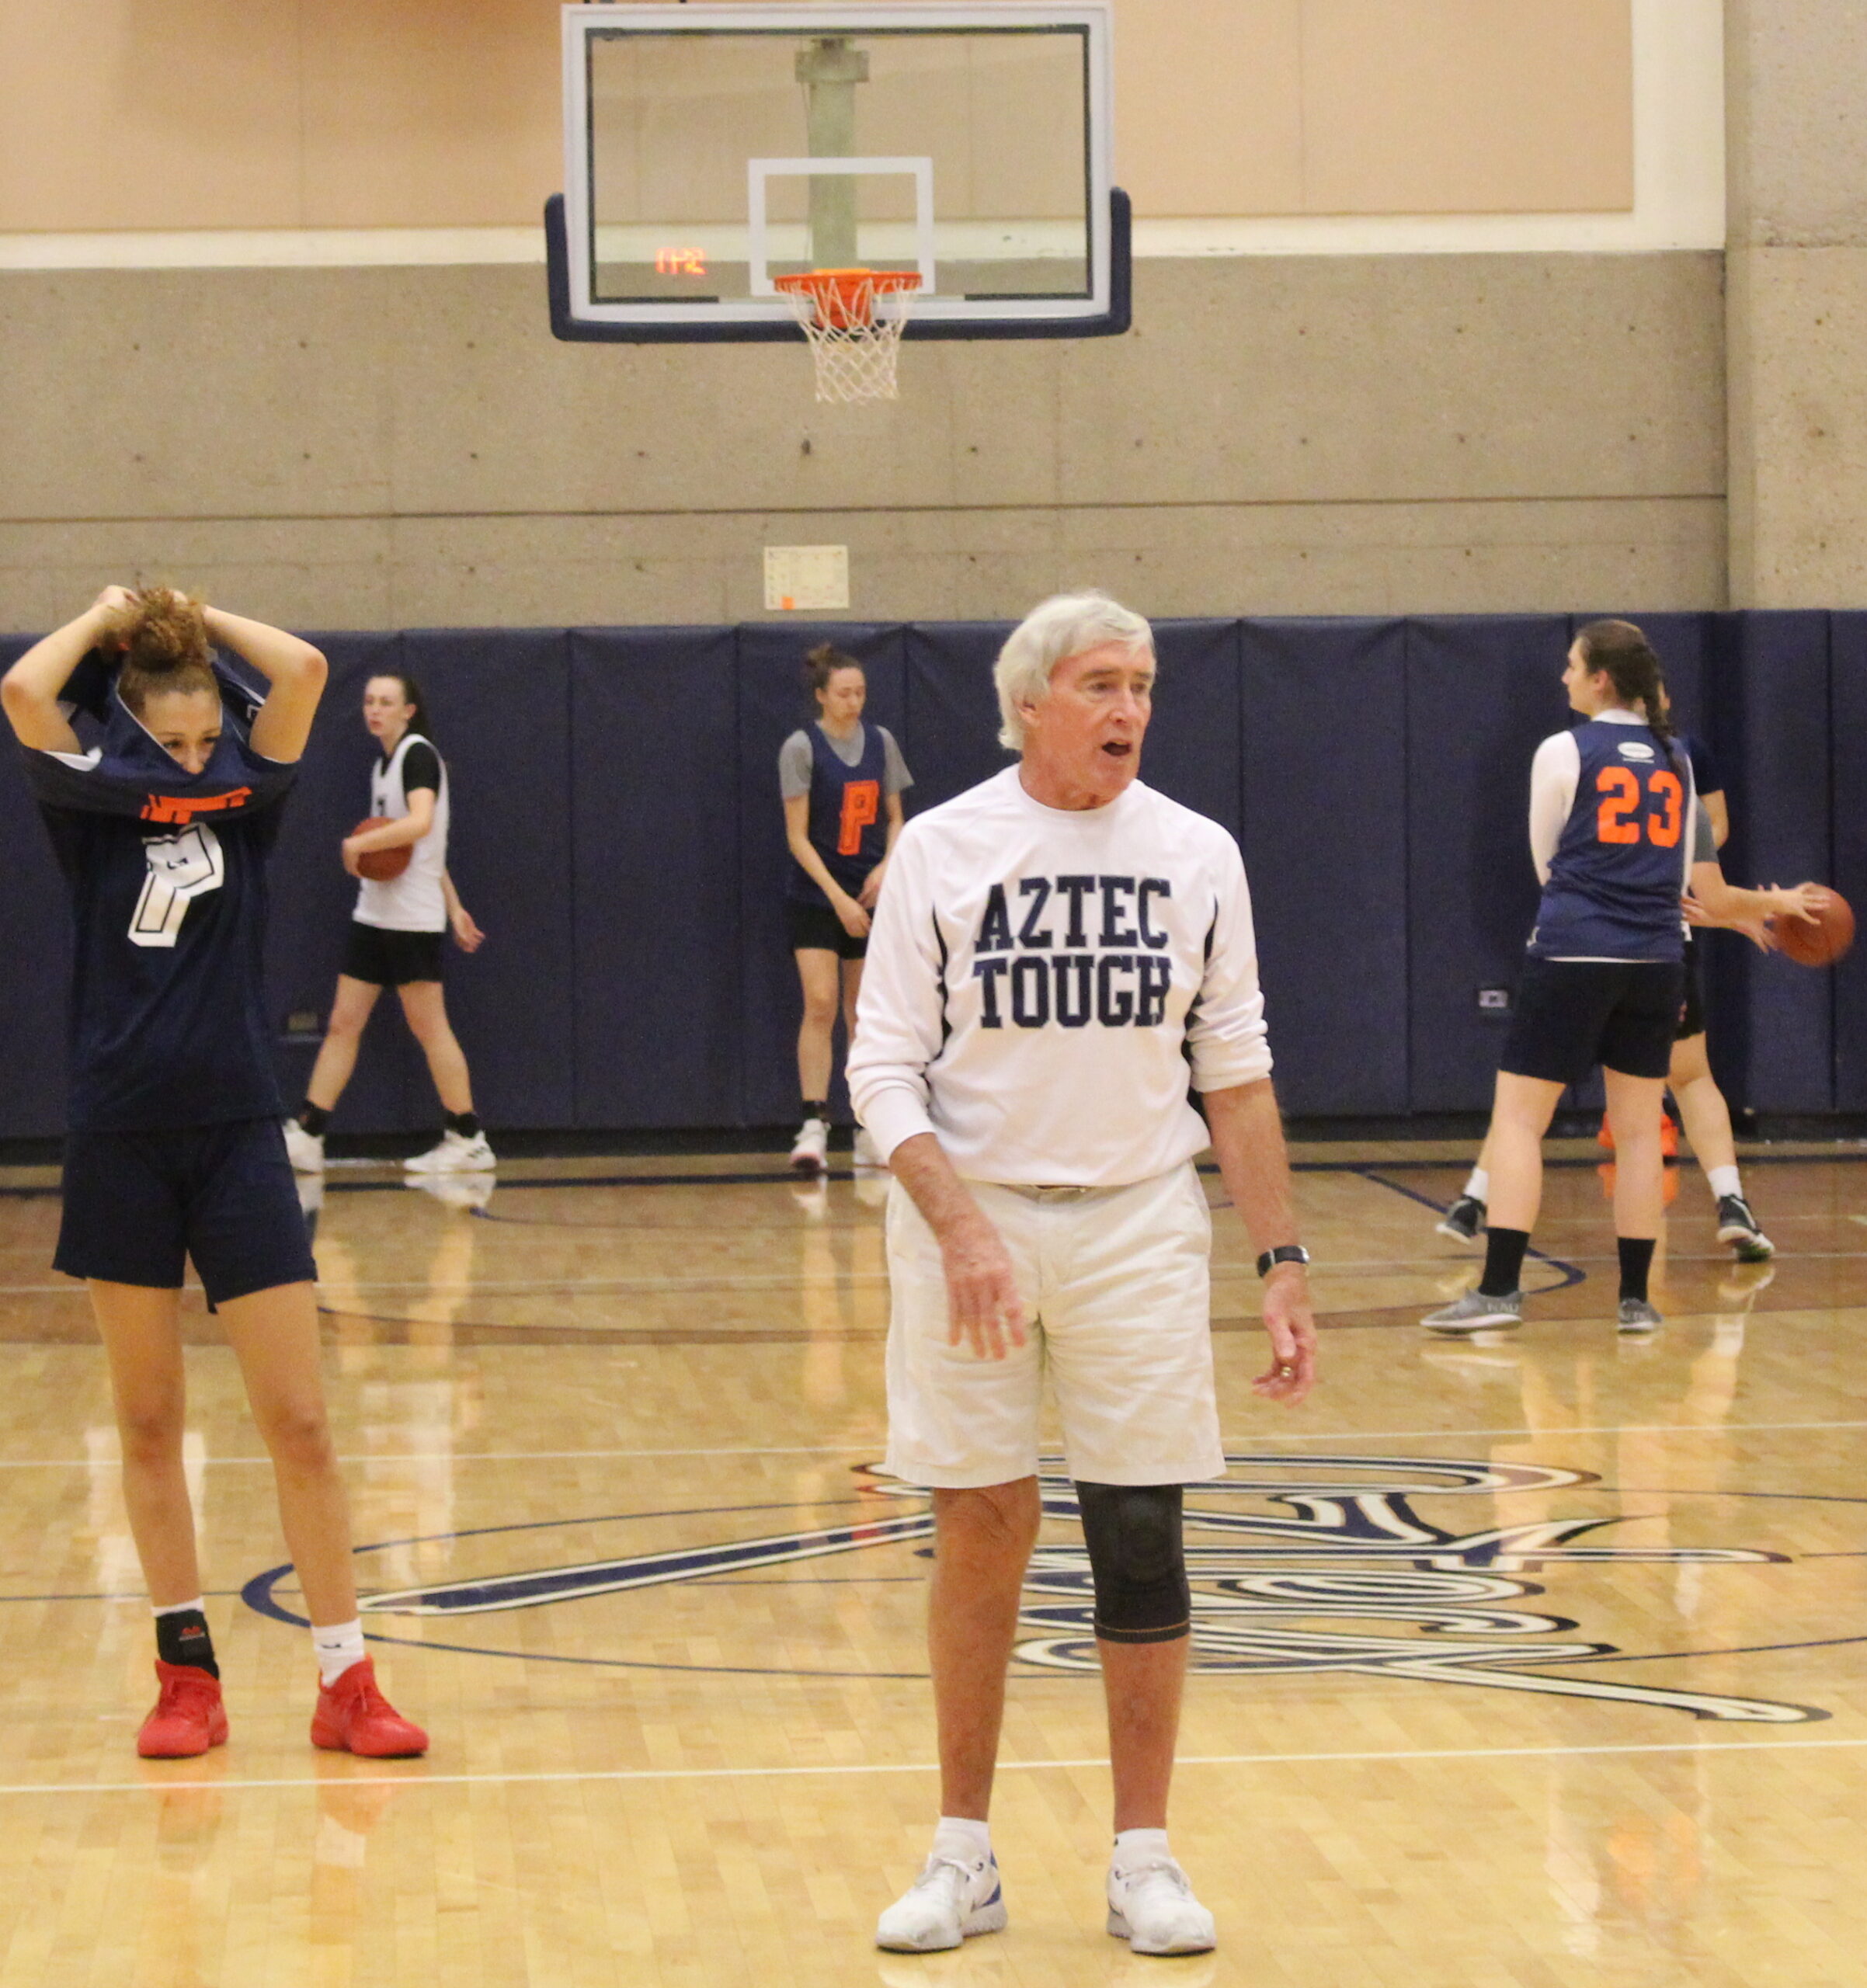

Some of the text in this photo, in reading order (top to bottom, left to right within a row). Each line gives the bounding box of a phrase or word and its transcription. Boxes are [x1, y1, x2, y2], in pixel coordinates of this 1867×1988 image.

[837, 780, 879, 856] P
[1595, 766, 1683, 848] 23
[974, 874, 1171, 953] AZTEC
[972, 954, 1172, 1029] TOUGH
